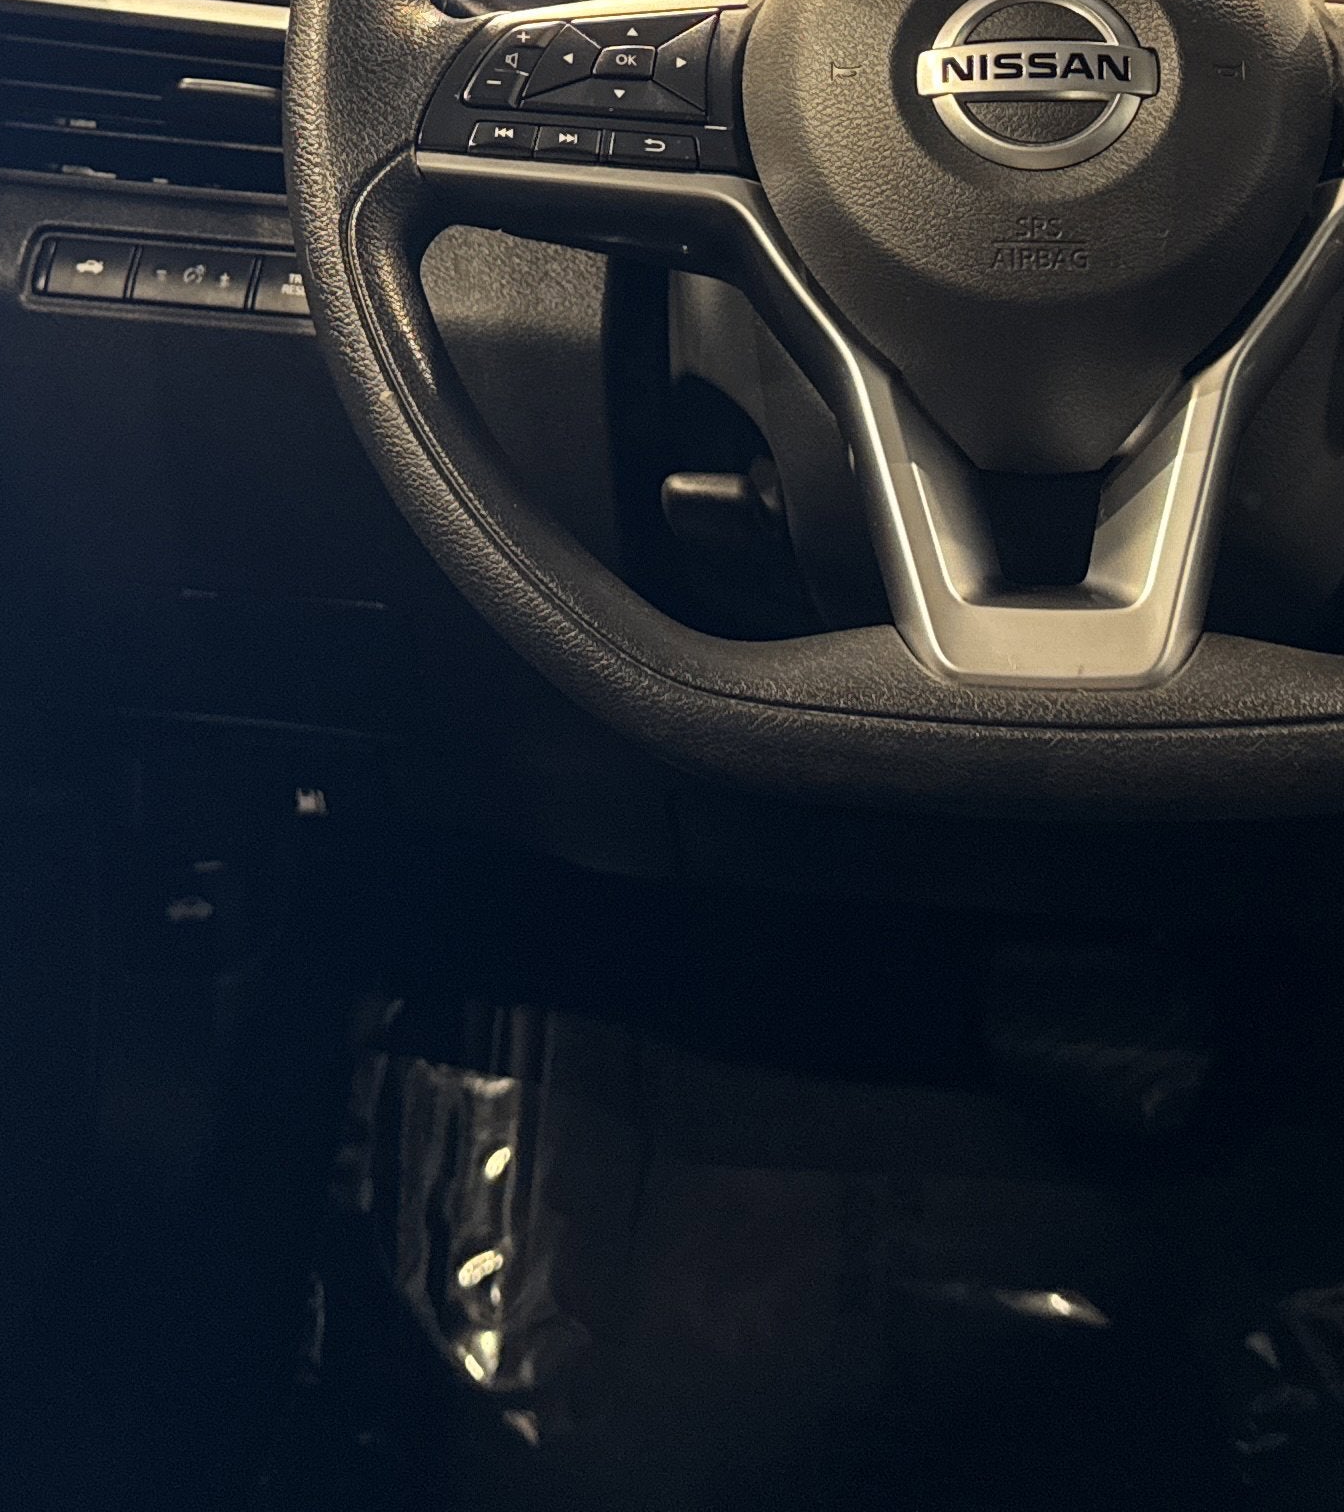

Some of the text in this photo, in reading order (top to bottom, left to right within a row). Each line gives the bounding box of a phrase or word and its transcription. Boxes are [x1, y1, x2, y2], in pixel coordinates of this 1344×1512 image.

[615, 54, 638, 67] OK
[941, 52, 1132, 84] NISSAN
[991, 247, 1091, 271] AIRBAG
